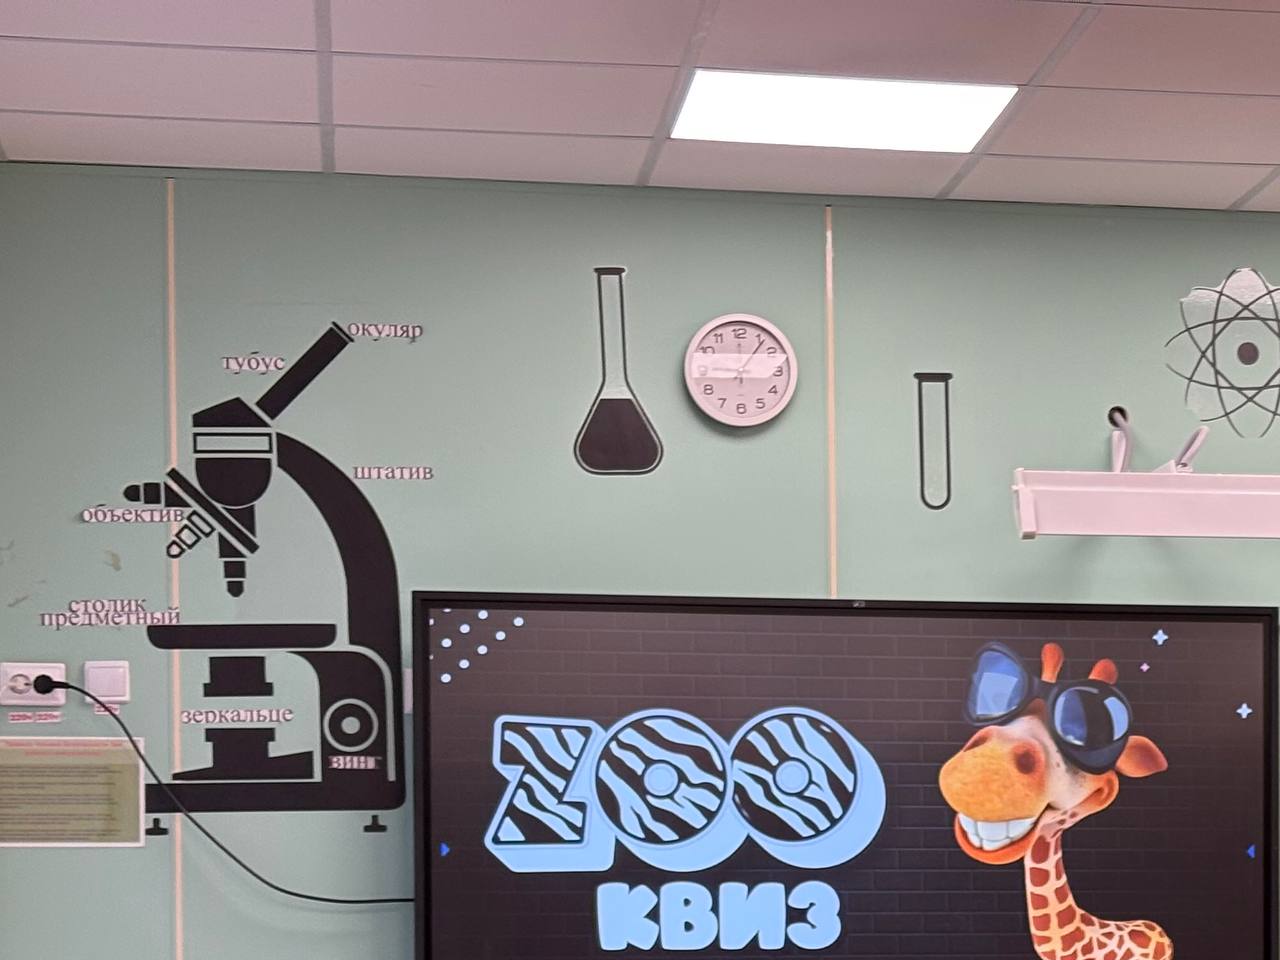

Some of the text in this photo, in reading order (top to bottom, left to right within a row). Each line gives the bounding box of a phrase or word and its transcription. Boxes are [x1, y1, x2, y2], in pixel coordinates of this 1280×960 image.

[347, 322, 423, 343] окуляр
[713, 333, 724, 343] 11
[731, 328, 747, 339] 12
[222, 351, 285, 375] тубус
[768, 385, 778, 395] 4
[718, 398, 727, 408] 7
[755, 398, 766, 409] 5
[353, 466, 434, 480] штатив
[82, 504, 184, 522] объектив
[68, 600, 147, 613] столик
[40, 607, 181, 630] предметный
[180, 709, 294, 724] зеркальце
[484, 706, 887, 873] ZOO
[597, 880, 842, 951] КВИЗ
